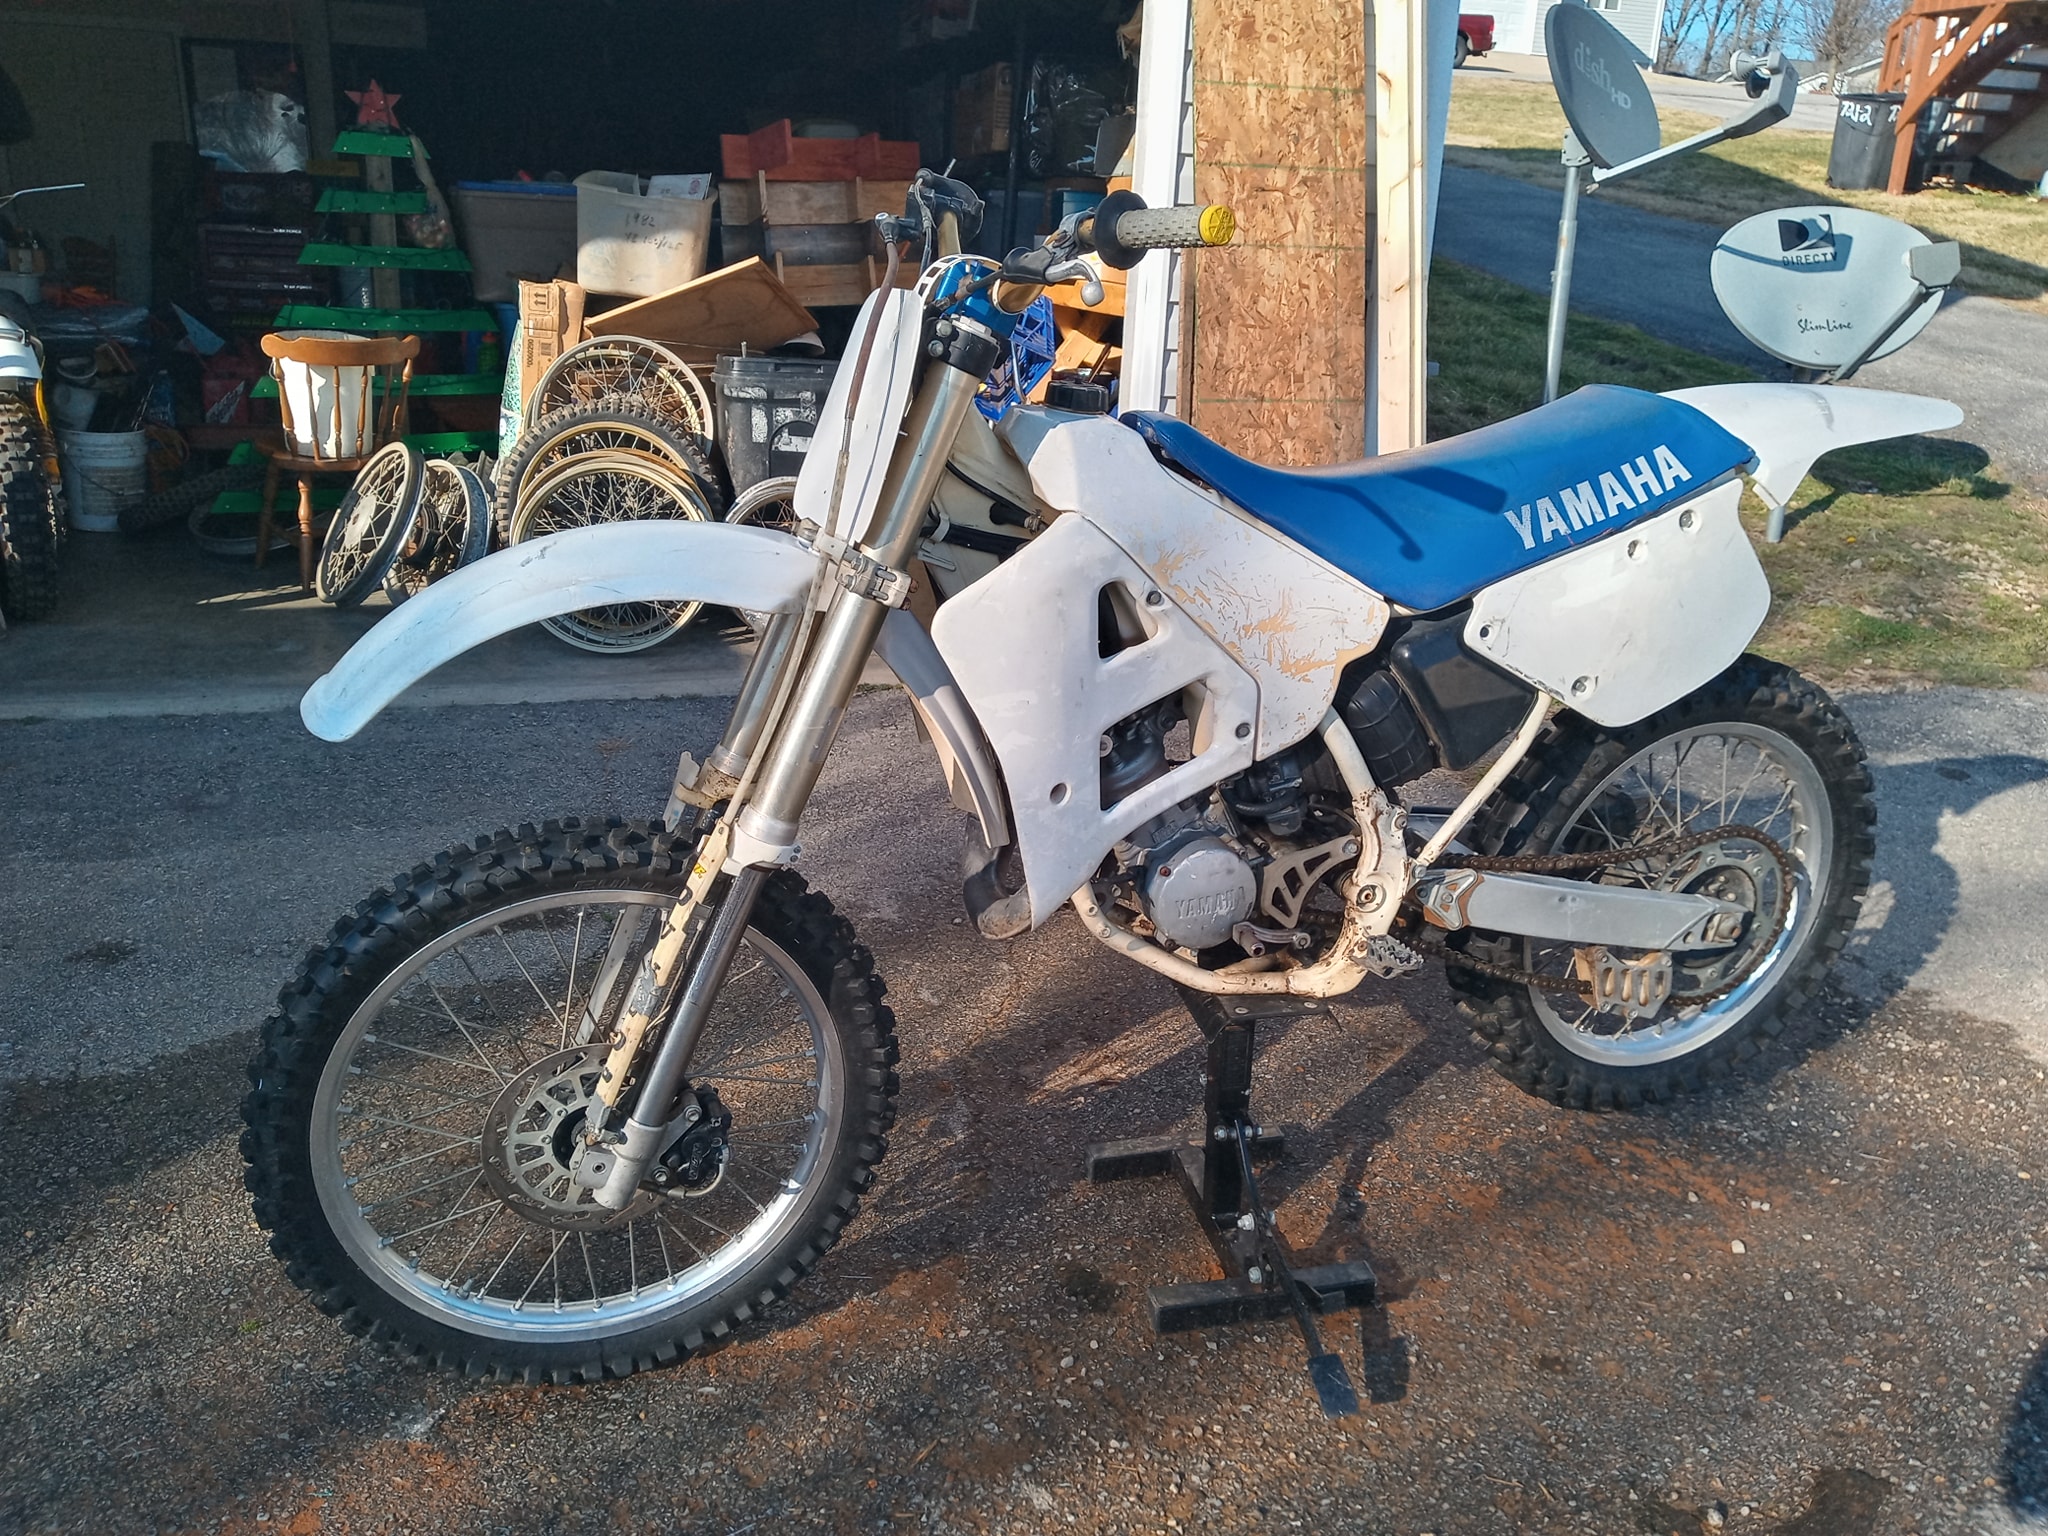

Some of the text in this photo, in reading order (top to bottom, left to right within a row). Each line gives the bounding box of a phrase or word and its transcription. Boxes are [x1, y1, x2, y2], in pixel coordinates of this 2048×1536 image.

[1574, 41, 1632, 110] dish HD
[1782, 251, 1838, 266] DIRECTV
[1503, 444, 1693, 551] YAMAHA
[1175, 886, 1246, 920] YAMAHA
